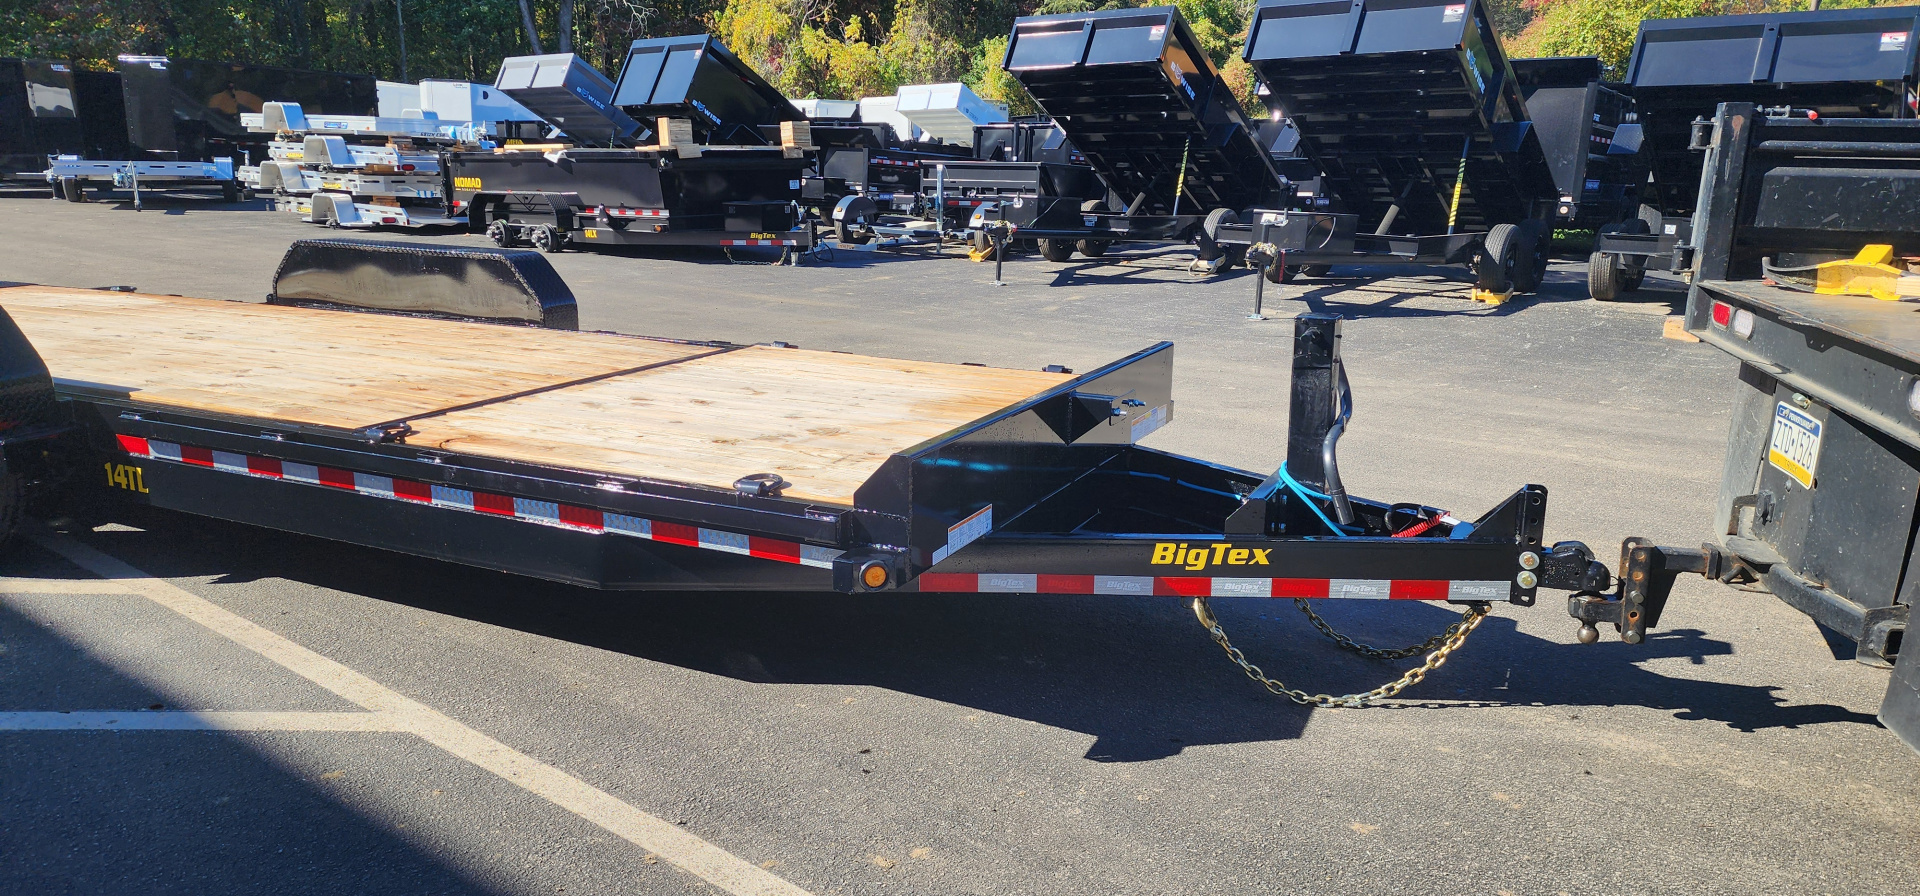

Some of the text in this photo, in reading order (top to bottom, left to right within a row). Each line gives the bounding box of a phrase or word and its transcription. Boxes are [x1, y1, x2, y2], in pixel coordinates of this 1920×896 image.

[454, 176, 482, 188] NOMAD
[750, 232, 777, 240] BigTex
[104, 461, 149, 494] 14TL
[1150, 542, 1273, 571] BigTex
